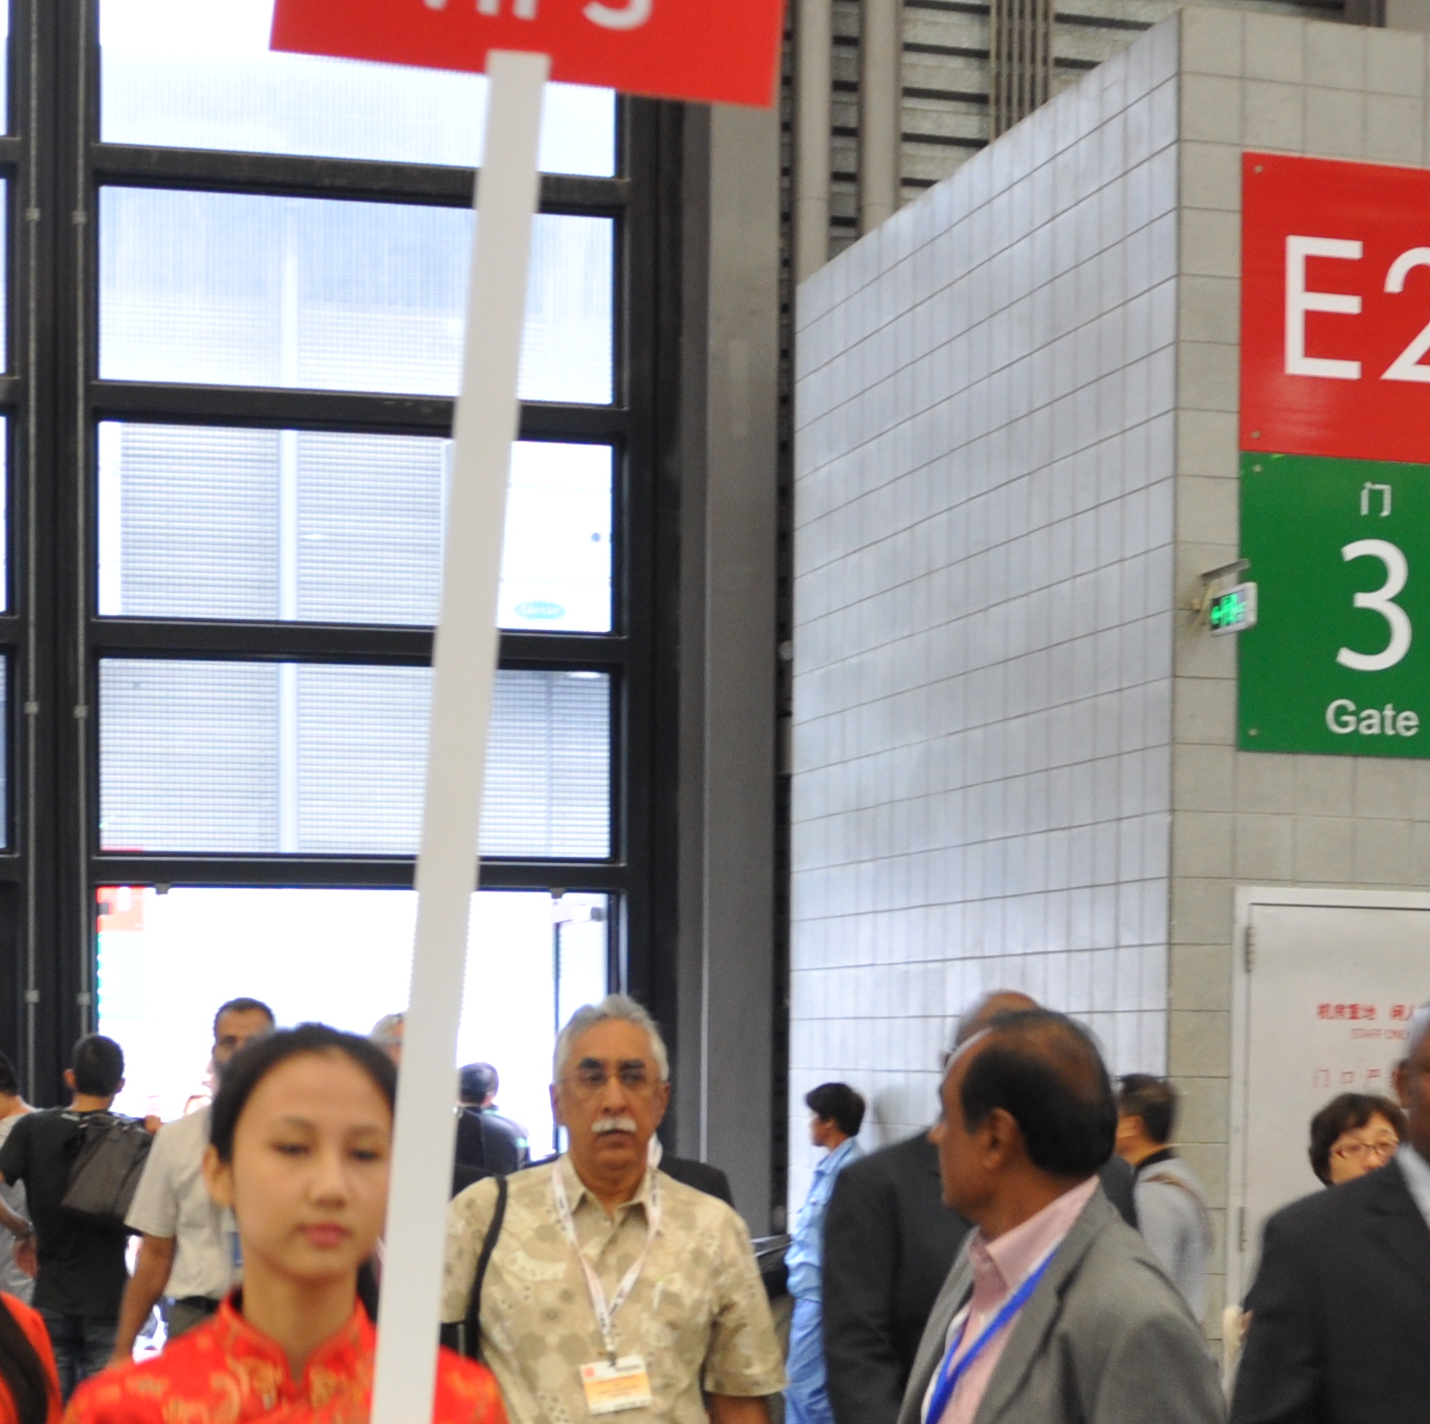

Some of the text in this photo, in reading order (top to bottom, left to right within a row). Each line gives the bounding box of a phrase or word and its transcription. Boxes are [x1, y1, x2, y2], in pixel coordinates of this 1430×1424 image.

[1359, 481, 1393, 517] 门
[1335, 538, 1413, 672] 3
[1324, 698, 1420, 738] Gate
